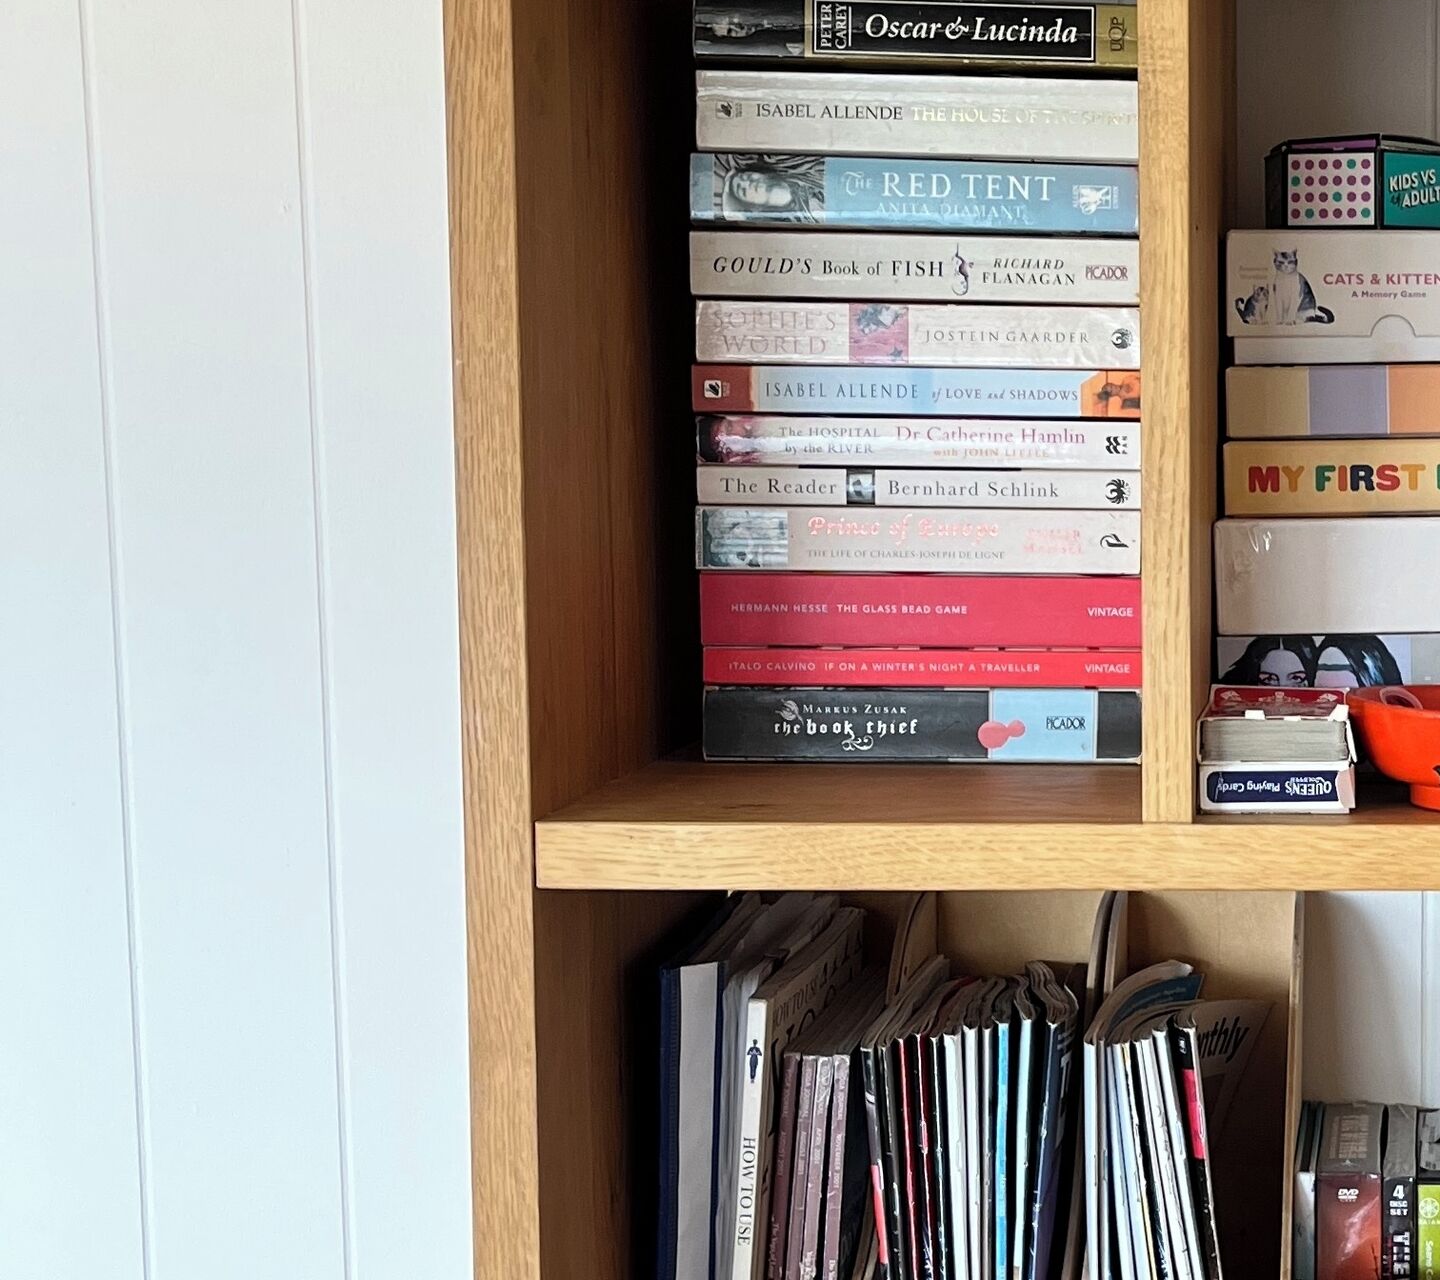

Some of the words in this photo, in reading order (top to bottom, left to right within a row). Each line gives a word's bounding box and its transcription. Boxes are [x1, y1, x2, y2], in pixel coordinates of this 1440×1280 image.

[865, 14, 941, 40] Oscar
[972, 17, 1079, 44] Lucinda
[882, 172, 952, 198] RED
[961, 174, 1057, 201] TENT
[1389, 172, 1419, 192] KIDS
[1420, 169, 1437, 185] VS
[712, 257, 814, 275] GOULD'S
[822, 260, 861, 276] Book
[867, 259, 882, 276] of
[890, 260, 944, 277] FISH
[993, 258, 1065, 271] RICHARD
[982, 271, 1076, 286] FLANAGAN
[1323, 273, 1364, 285] CATS
[1370, 273, 1381, 285] &
[1351, 291, 1359, 299] A
[1361, 291, 1398, 301] Memory
[1400, 291, 1428, 299] Game
[925, 329, 999, 344] JOSTEIN
[1006, 329, 1090, 344] GAARDER
[720, 477, 760, 494] The
[768, 478, 838, 496] Reader
[887, 479, 980, 498] Bernhard
[987, 480, 1060, 498] Schlink
[1248, 466, 1306, 494] MY
[1313, 464, 1427, 493] FIRST
[731, 603, 789, 613] HERMANN
[794, 603, 828, 613] HESSE
[836, 604, 859, 614] THE
[862, 604, 897, 614] GLASS
[902, 604, 932, 614] BEAD
[935, 605, 968, 615] GAME
[1087, 607, 1134, 617] VINTAGE
[802, 703, 859, 714] MARKUS
[863, 704, 907, 714] ZUSAK
[774, 719, 801, 736] the
[806, 719, 854, 737] book
[866, 718, 918, 736] thief
[742, 1137, 757, 1180] HOW
[740, 1182, 755, 1209] TO
[737, 1210, 754, 1246] USE
